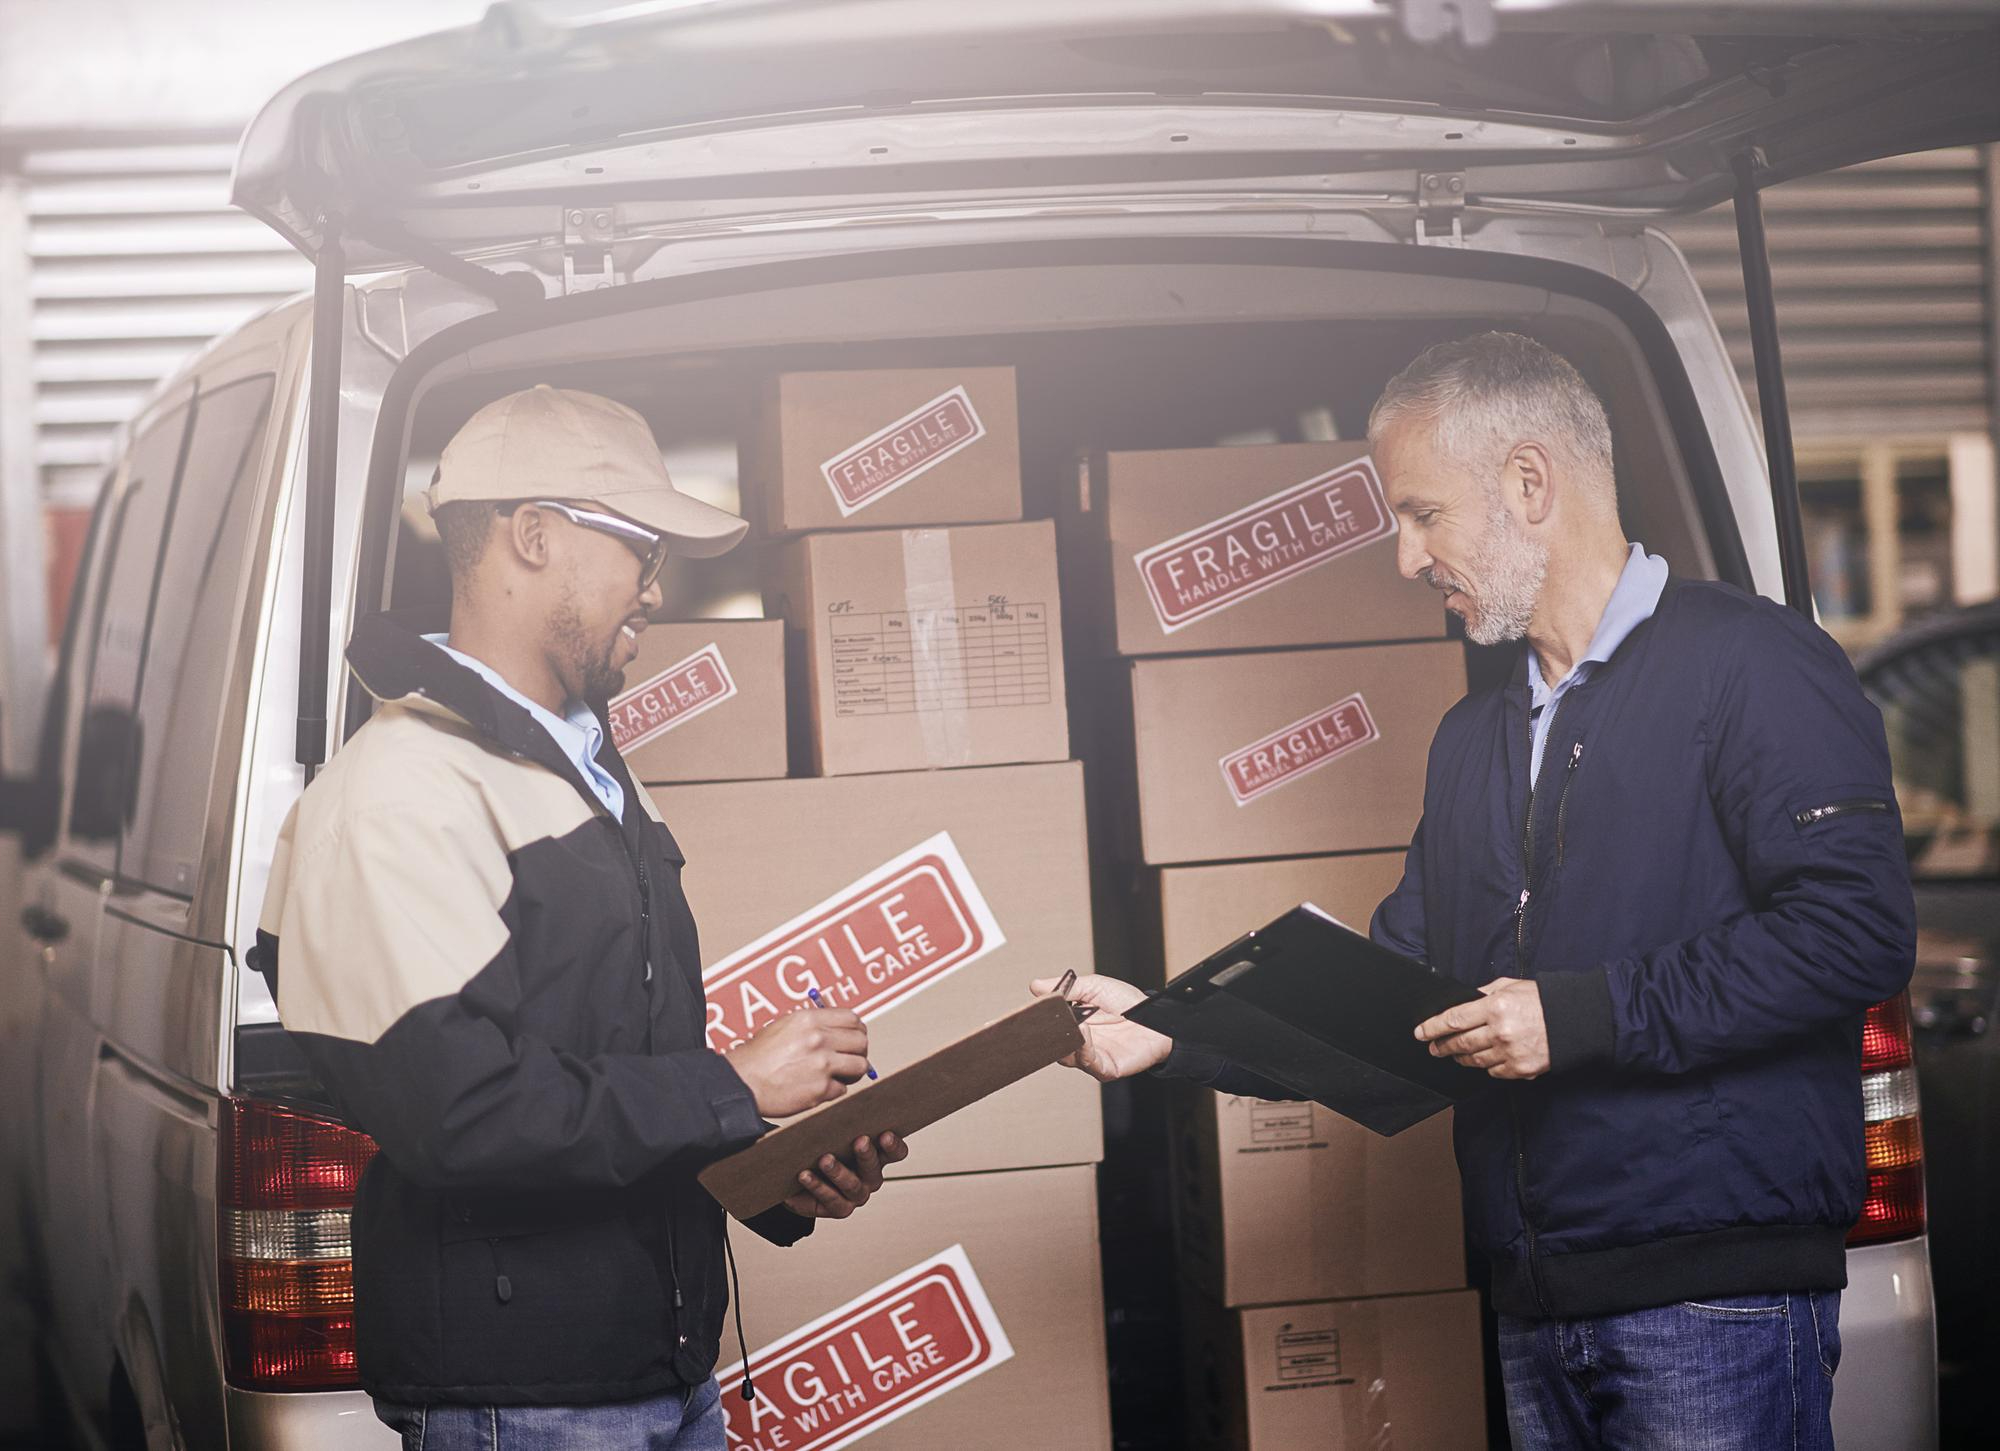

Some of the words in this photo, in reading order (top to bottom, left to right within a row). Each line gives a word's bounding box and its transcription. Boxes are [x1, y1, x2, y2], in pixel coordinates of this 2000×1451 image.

[842, 411, 953, 485] FRAGILE
[852, 463, 897, 494] HANDLE
[899, 447, 928, 467] WITH
[931, 428, 959, 449] CARE
[1165, 487, 1352, 590] FRAGILE
[1177, 562, 1253, 605] HANDLE
[1257, 541, 1305, 570] WITH
[1311, 516, 1360, 547] CARE
[608, 667, 705, 735] RAGILE
[614, 721, 646, 743] NDLE
[648, 703, 678, 724] WITH
[679, 684, 711, 707] CARE
[1236, 711, 1350, 780] FRAGILE
[706, 893, 924, 1050] RAGILE
[787, 976, 860, 1013] TH
[865, 932, 937, 985] CARE
[724, 1301, 933, 1442] RAGILE
[793, 1384, 866, 1434] WITH
[872, 1342, 944, 1392] CARE
